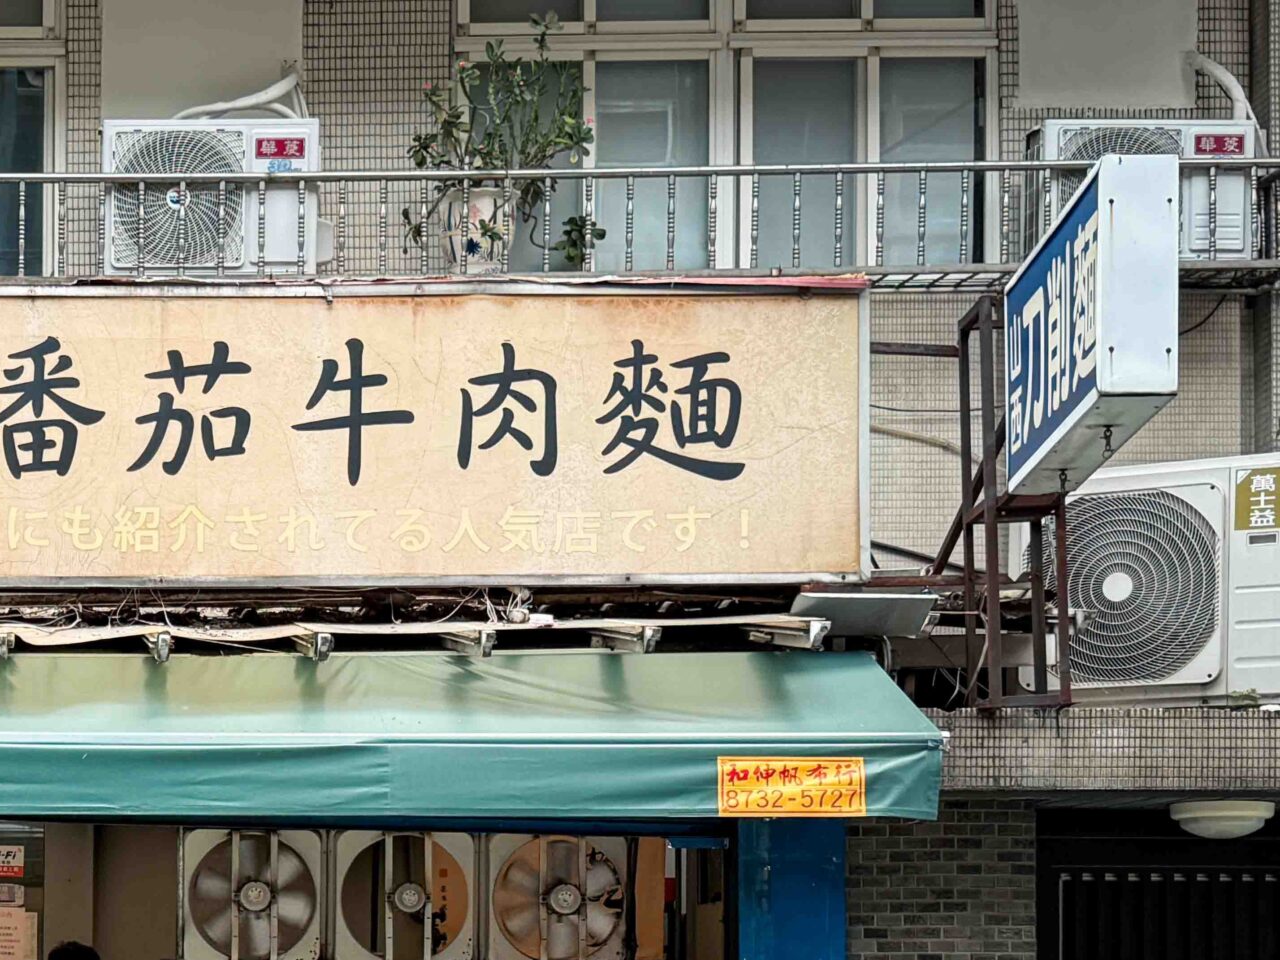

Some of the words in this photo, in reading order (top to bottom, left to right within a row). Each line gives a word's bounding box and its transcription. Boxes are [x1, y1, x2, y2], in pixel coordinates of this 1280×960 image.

[1249, 474, 1277, 527] 萬士益
[726, 789, 858, 809] 8732-5727
